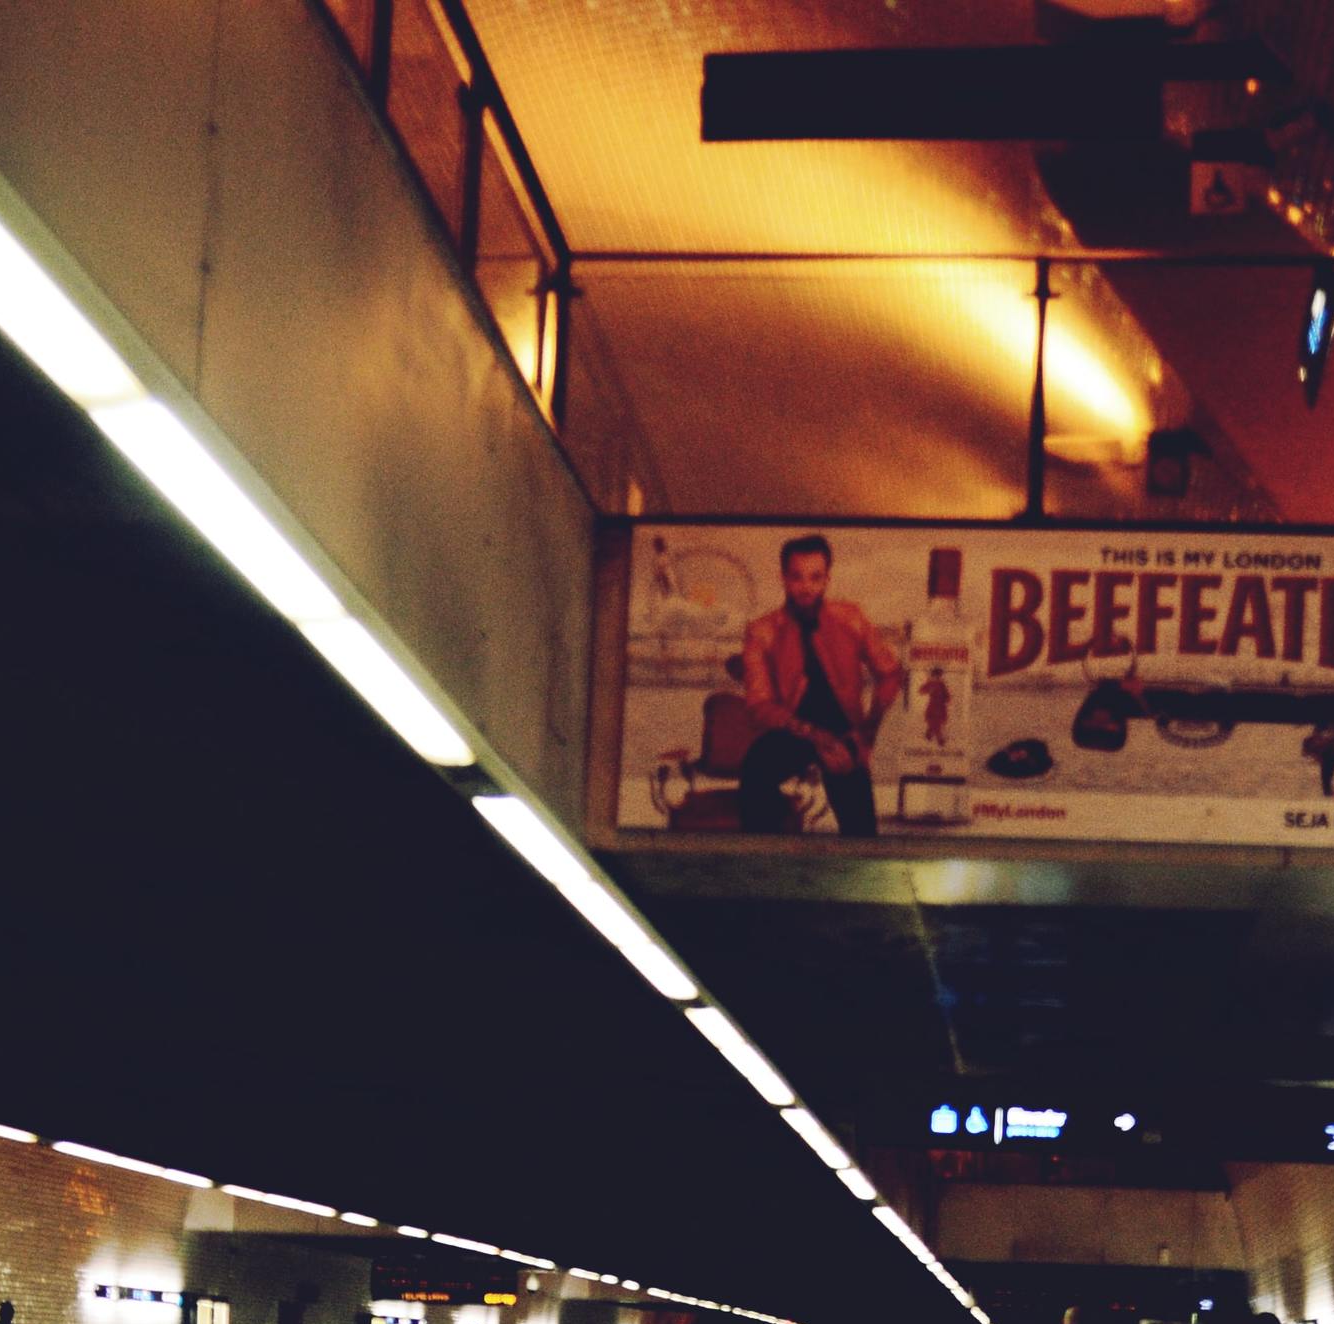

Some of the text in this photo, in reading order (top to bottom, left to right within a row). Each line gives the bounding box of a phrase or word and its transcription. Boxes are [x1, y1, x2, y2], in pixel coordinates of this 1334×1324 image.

[1101, 547, 1322, 571] THIS IS MY LONDON
[1284, 811, 1329, 829] SEJA
